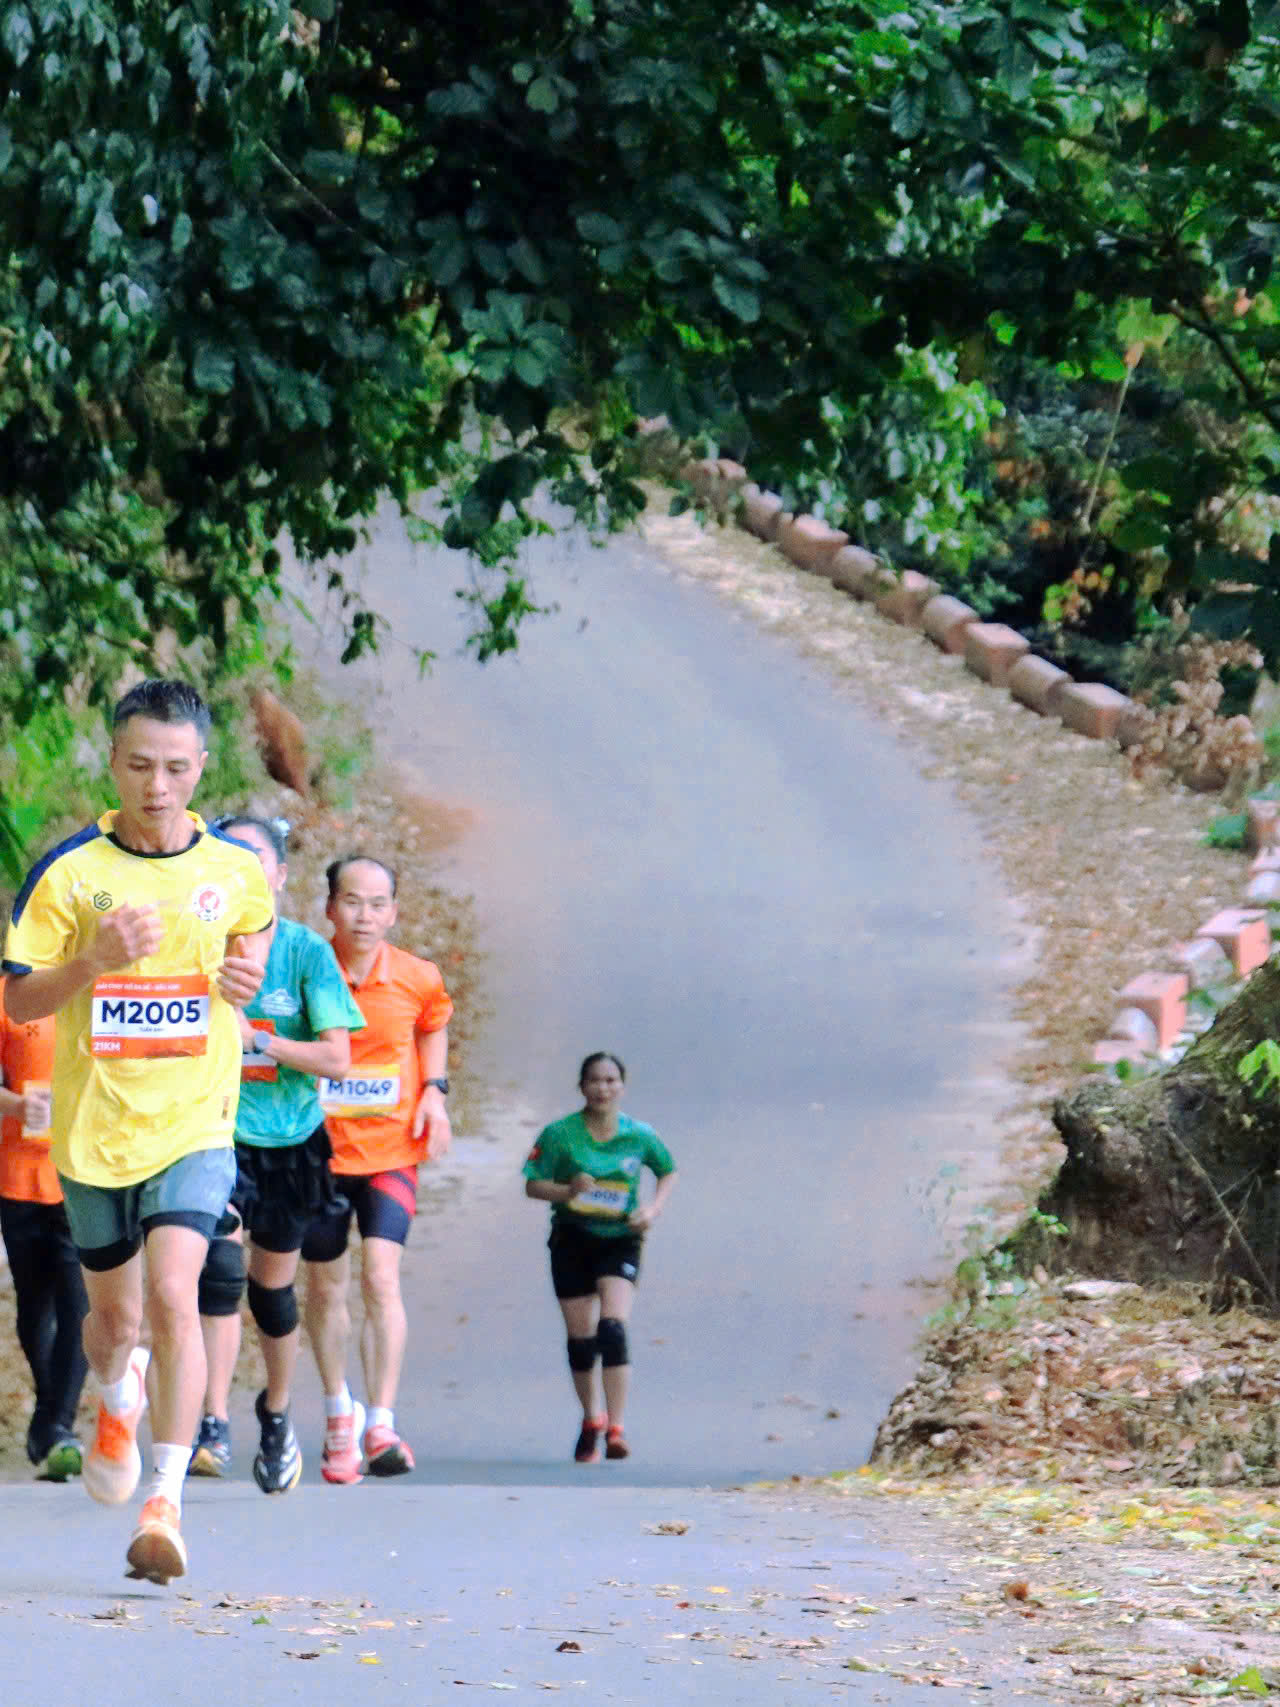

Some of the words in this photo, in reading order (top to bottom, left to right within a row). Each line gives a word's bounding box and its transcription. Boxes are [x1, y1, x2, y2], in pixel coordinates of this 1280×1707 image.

[101, 999, 201, 1025] M2005
[94, 1041, 121, 1052] 21KM
[328, 1078, 393, 1096] M1049
